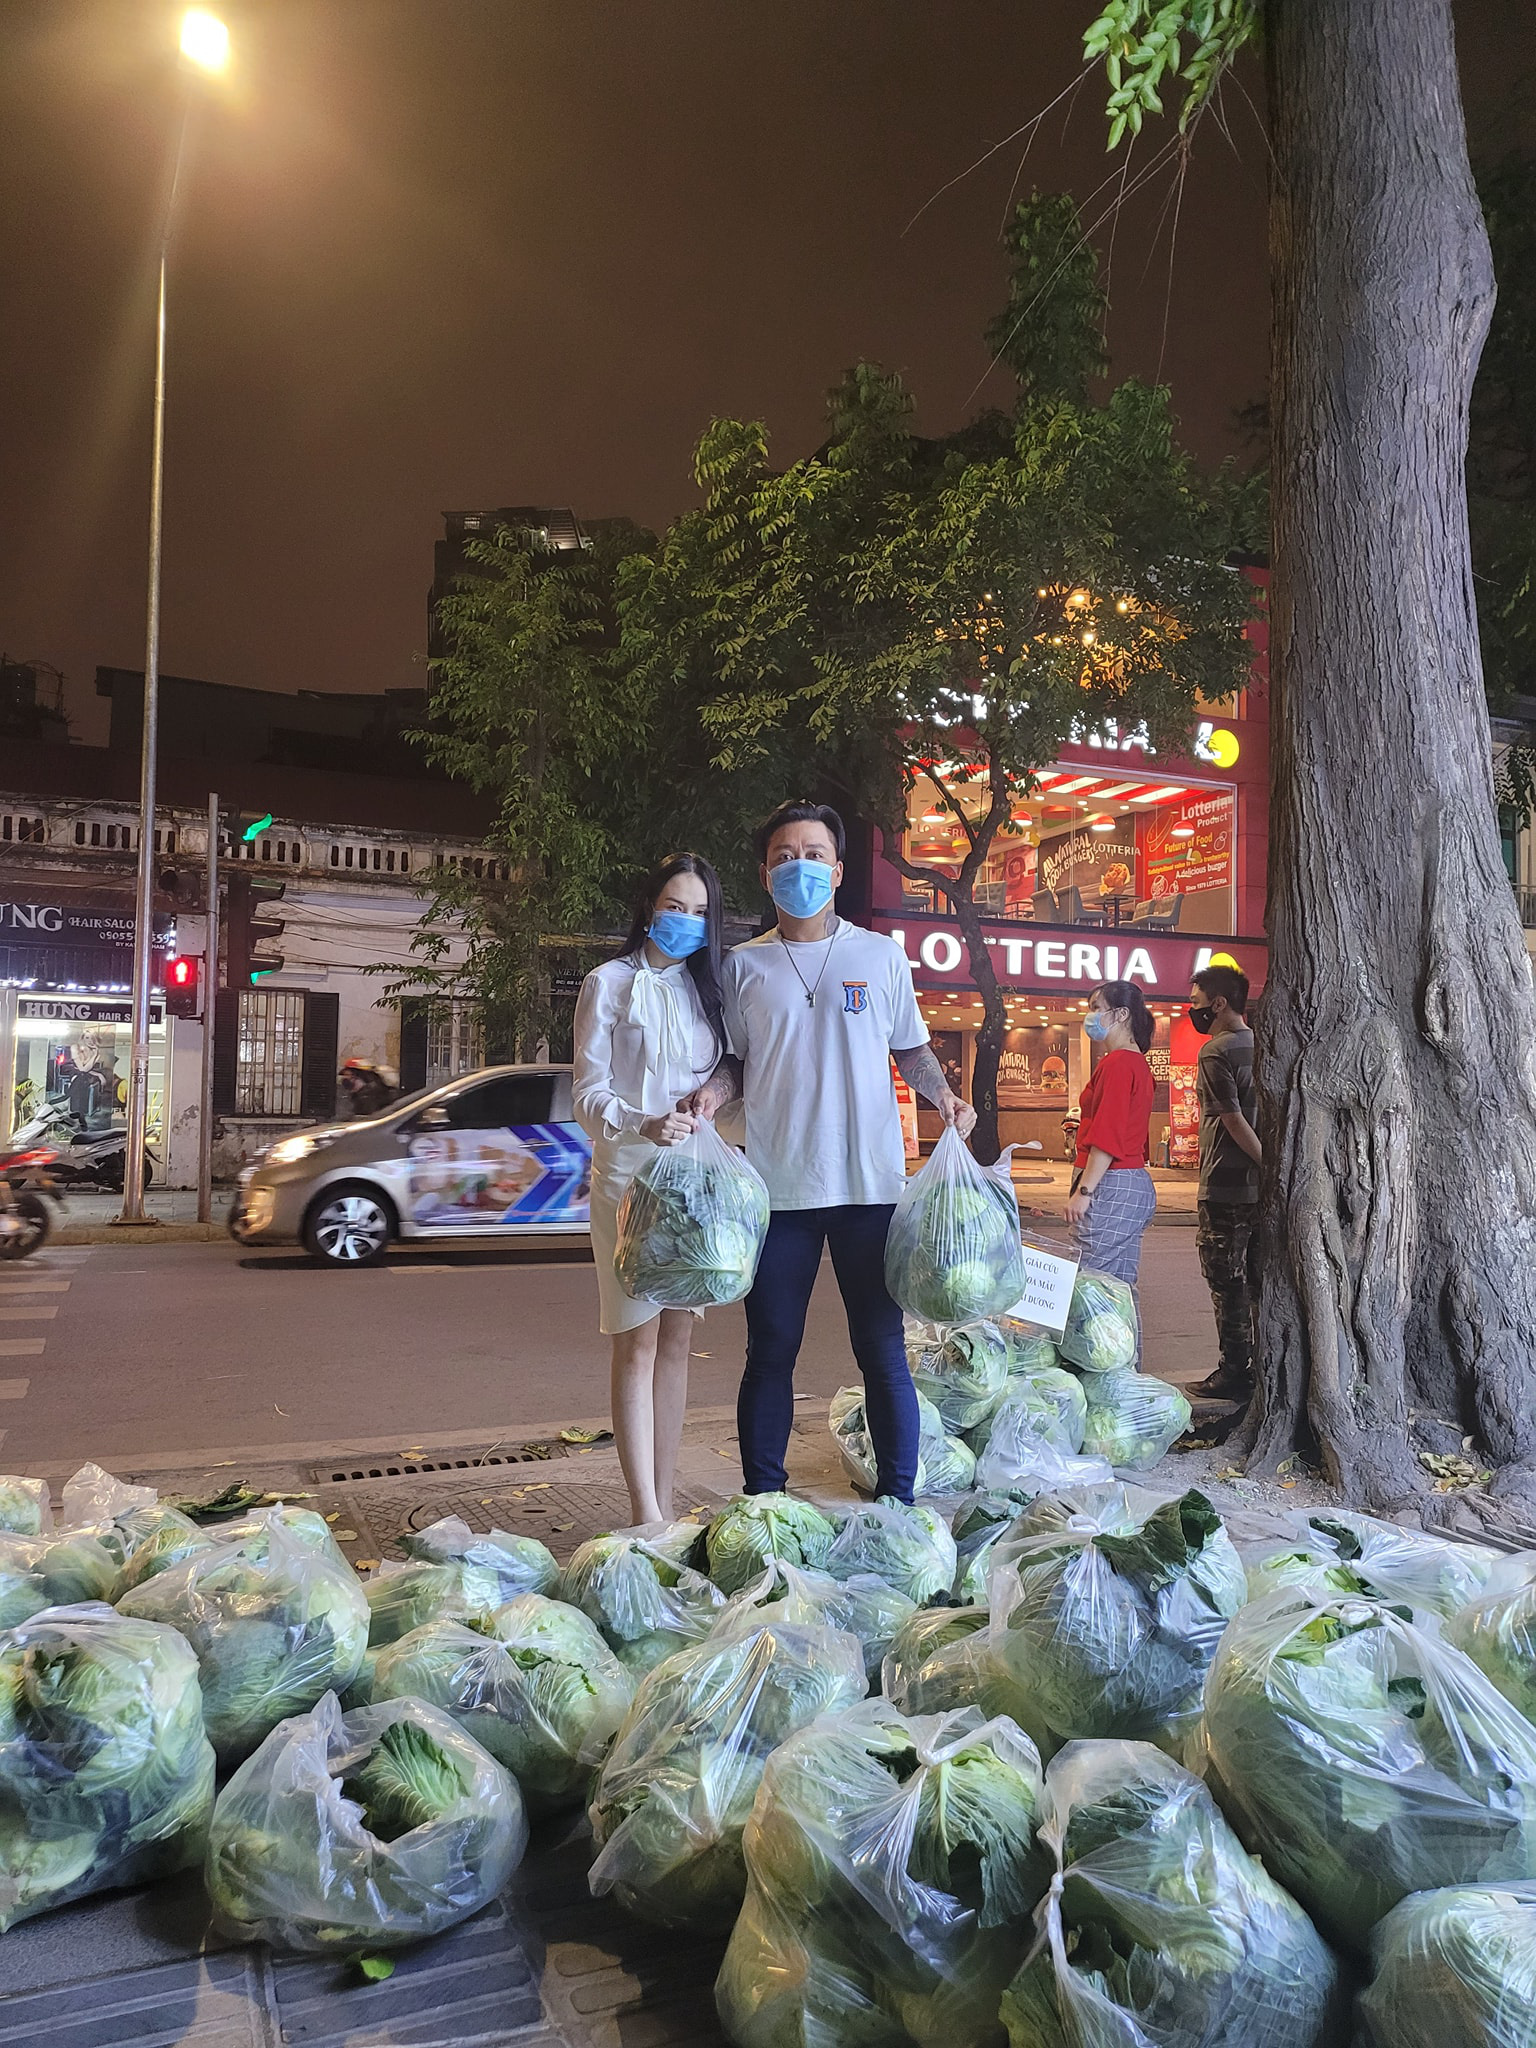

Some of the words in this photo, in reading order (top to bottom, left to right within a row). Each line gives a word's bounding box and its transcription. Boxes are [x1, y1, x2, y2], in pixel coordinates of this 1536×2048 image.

[1197, 812, 1228, 828] Product
[1054, 832, 1091, 863] NATURAL
[1164, 842, 1186, 854] Future
[1187, 836, 1195, 847] of
[1196, 834, 1213, 846] Food
[104, 918, 137, 930] SALO
[98, 1011, 121, 1022] HAIR
[998, 1050, 1030, 1071] NATURAL
[1152, 1056, 1170, 1065] BEST
[1042, 1262, 1059, 1275] CỨU
[1028, 1295, 1055, 1310] DƯƠNG
